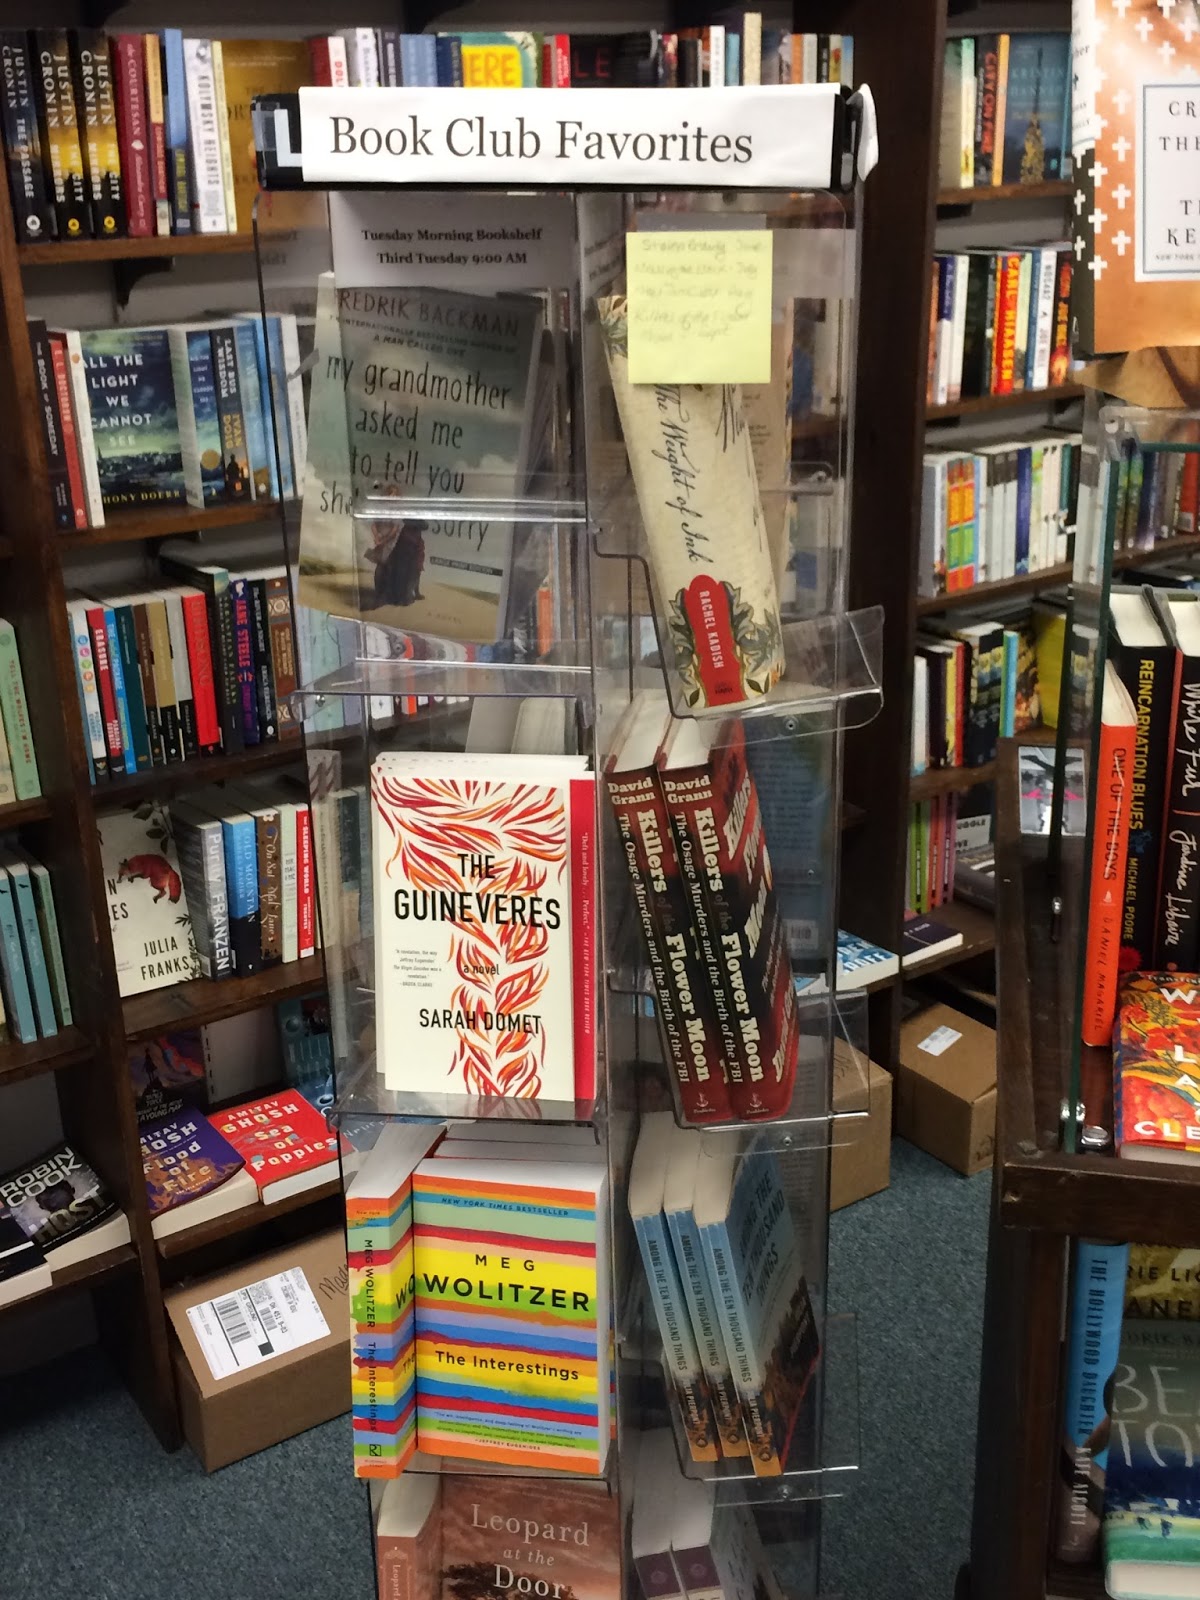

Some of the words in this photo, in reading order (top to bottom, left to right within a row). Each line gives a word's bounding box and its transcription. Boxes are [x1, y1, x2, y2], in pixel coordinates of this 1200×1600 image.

[2, 45, 17, 109] CRONIN
[12, 47, 29, 108] JUSTIN
[40, 50, 60, 129] CRONIN
[53, 55, 75, 127] JUSTIN
[81, 50, 98, 127] CRONIN
[94, 53, 115, 126] JUSTIN
[127, 58, 141, 136] COURTESAN
[16, 118, 27, 141] THE
[329, 114, 434, 157] Book
[445, 115, 542, 159] Club
[554, 120, 753, 164] Favorites
[19, 143, 34, 199] PASSAGE
[71, 172, 83, 202] CITY
[108, 171, 120, 201] CITY
[361, 229, 414, 244] Tuesday
[416, 229, 474, 243] Morning
[476, 227, 543, 241] Bookshelf
[376, 252, 414, 265] Third
[416, 252, 469, 266] Tuesday
[472, 254, 503, 265] 9:00
[505, 252, 528, 264] AM
[1005, 256, 1021, 299] CARL
[419, 301, 520, 338] BACKMAN
[113, 353, 144, 367] THE
[224, 338, 234, 369] LAST
[1000, 309, 1017, 381] HIAASEN
[91, 374, 139, 389] LIGHT
[216, 346, 229, 399] WISDOM
[227, 370, 237, 394] BUS
[327, 354, 354, 393] my
[364, 361, 513, 411] grandmother
[37, 358, 49, 390] BOOK
[44, 405, 59, 456] SOMEDAY
[105, 395, 130, 409] WE
[90, 413, 152, 429] CANNOT
[222, 413, 235, 450] DOIG
[232, 413, 243, 448] IVAN
[355, 405, 419, 442] asked
[431, 419, 464, 450] me
[108, 434, 136, 447] SEE
[351, 446, 372, 477] to
[384, 451, 419, 486] tell
[429, 464, 466, 497] you
[650, 417, 701, 499] Weight
[140, 489, 181, 501] DOERR
[664, 495, 703, 519] of
[680, 520, 715, 564] Ink
[236, 599, 248, 626] JANE
[699, 590, 715, 630] RACHEL
[707, 631, 725, 670] KADISH
[95, 628, 109, 672] ERASURE
[237, 628, 251, 668] STEELE
[1132, 658, 1156, 780] REINCARNATION
[1111, 747, 1127, 779] ONE
[607, 776, 654, 794] David
[611, 791, 656, 806] Grann
[663, 774, 712, 793] David
[667, 788, 713, 805] Grann
[1129, 781, 1147, 831] BLUES
[617, 812, 631, 840] The
[673, 810, 688, 839] The
[265, 843, 276, 860] On
[457, 853, 496, 880] THE
[624, 840, 641, 881] Osage
[680, 839, 697, 880] Osage
[244, 863, 257, 923] MOUNTAIN
[1124, 857, 1139, 904] MICHAEL
[393, 888, 562, 930] GUINEVERES
[633, 882, 655, 939] Murders
[688, 881, 710, 938] Murders
[1122, 905, 1137, 941] POORE
[143, 936, 179, 958] JULIA
[212, 894, 230, 971] FRANZEN
[636, 808, 668, 894] Killers
[664, 932, 697, 1015] Flower
[684, 1016, 711, 1082] Moon
[693, 806, 725, 893] Killers
[720, 931, 751, 1015] Flower
[739, 1016, 766, 1083] Moon
[647, 938, 662, 964] and
[702, 938, 718, 964] and
[140, 955, 190, 981] FRANKS
[463, 965, 470, 974] a
[472, 964, 500, 976] novel
[653, 964, 666, 987] the
[707, 964, 721, 987] the
[419, 1007, 477, 1031] SARAH
[483, 1011, 542, 1035] DOMET
[658, 988, 676, 1022] Birth
[712, 988, 731, 1022] Birth
[667, 1022, 681, 1037] of
[720, 1022, 735, 1037] of
[670, 1037, 684, 1059] the
[724, 1037, 737, 1060] the
[675, 1060, 690, 1083] FBI
[729, 1060, 744, 1084] FBI
[221, 1103, 300, 1135] GHOSH
[227, 1100, 280, 1121] AMITAV
[253, 1124, 295, 1141] Sea
[142, 1140, 202, 1175] Flood
[168, 1160, 195, 1176] of
[250, 1136, 339, 1173] Poppies
[0, 1146, 75, 1198] ROBIN
[6, 1156, 83, 1208] COOK
[162, 1165, 212, 1193] Fire
[441, 1196, 460, 1207] NEW
[463, 1198, 486, 1209] YORK
[488, 1201, 514, 1212] TIMES
[516, 1204, 570, 1217] BESTSELLER
[363, 1238, 374, 1264] MEG
[474, 1253, 536, 1272] MEG
[647, 1239, 663, 1274] AMONG
[680, 1233, 694, 1269] AMONG
[713, 1247, 728, 1277] AMONG
[654, 1267, 667, 1285] THE
[686, 1263, 698, 1281] THE
[718, 1276, 731, 1294] THE
[1089, 1259, 1108, 1282] THE
[364, 1267, 377, 1329] WOLITZER
[422, 1272, 591, 1313] WOLITZER
[658, 1284, 671, 1301] TEN
[690, 1280, 703, 1297] TEN
[722, 1293, 734, 1310] TEN
[662, 1299, 681, 1343] THOUSAND
[695, 1296, 714, 1338] THOUSAND
[727, 1310, 746, 1354] THOUSAND
[1083, 1288, 1106, 1366] HOLLYWOOD
[367, 1341, 377, 1363] The
[434, 1350, 467, 1367] The
[472, 1354, 580, 1382] Interestings
[673, 1343, 688, 1372] THINGS
[706, 1338, 721, 1367] THINGS
[739, 1353, 754, 1383] THINGS
[368, 1364, 378, 1434] Interestings
[1077, 1371, 1099, 1435] DAUGHTER
[1073, 1447, 1093, 1477] KATE
[1069, 1483, 1090, 1526] ALCOTT
[470, 1503, 591, 1547] Leopard
[503, 1548, 520, 1561] at
[527, 1549, 555, 1567] the
[393, 1563, 402, 1595] Leopard
[493, 1563, 566, 1600] Door
